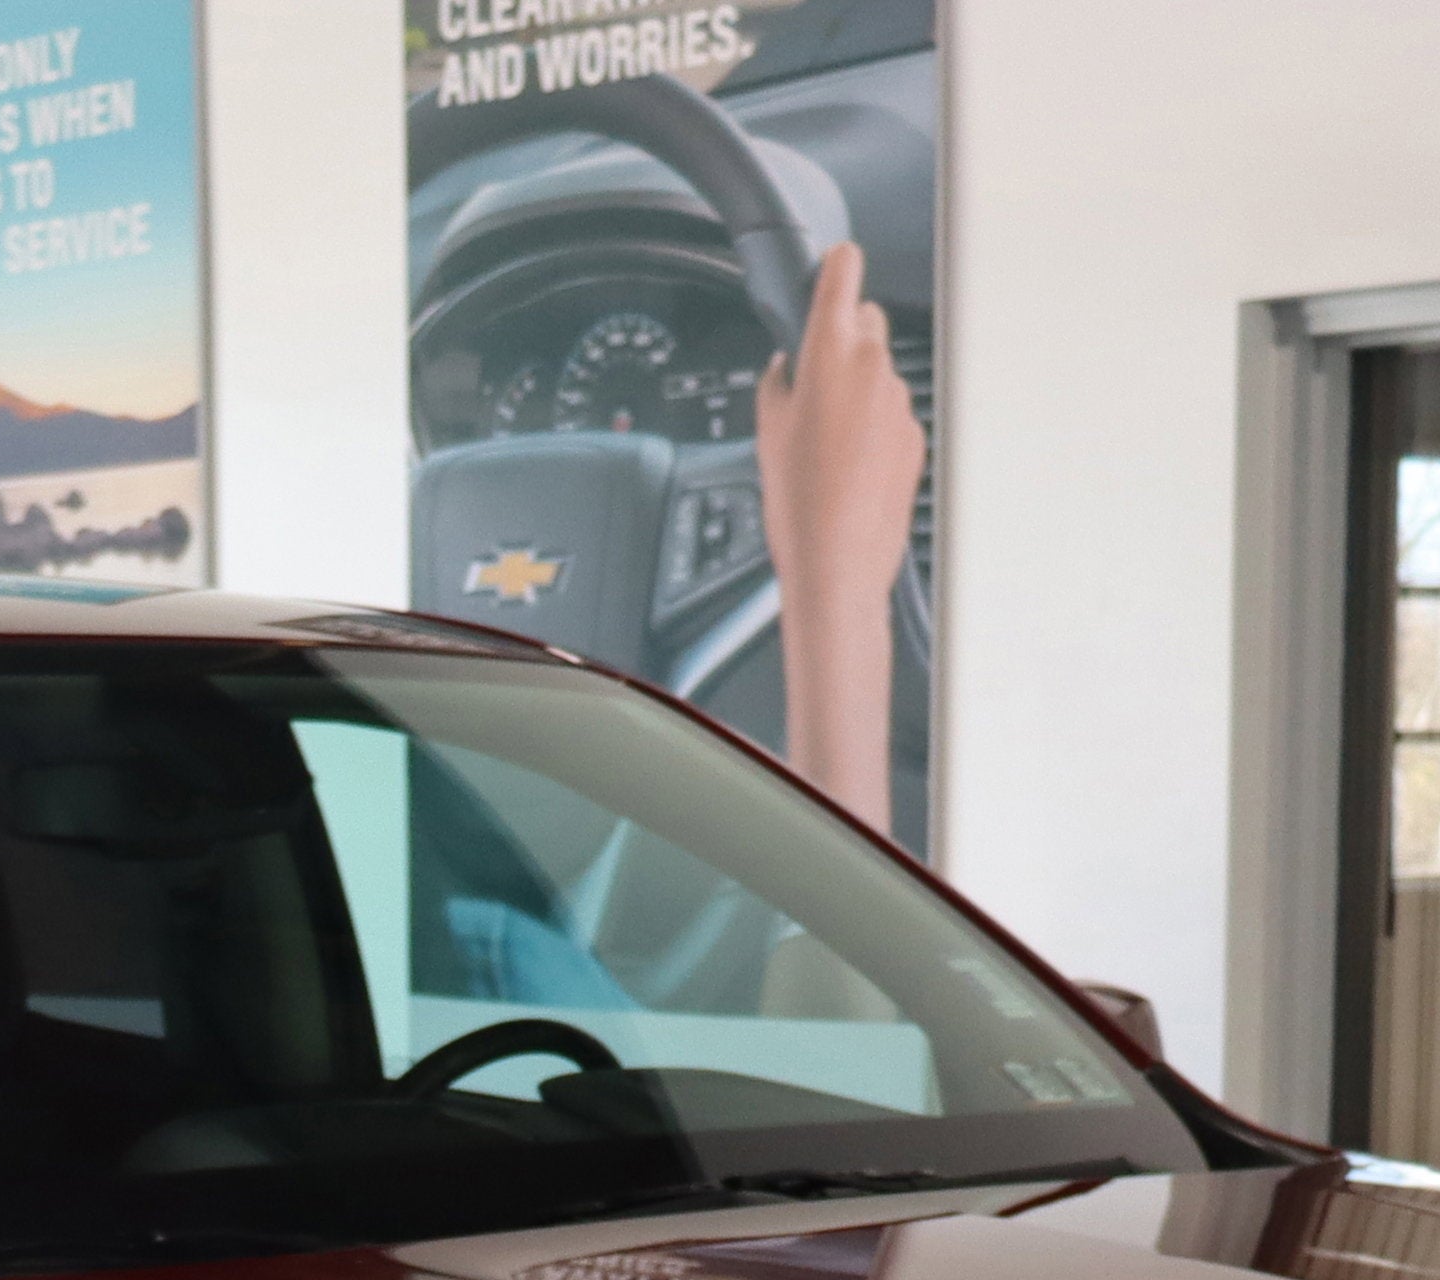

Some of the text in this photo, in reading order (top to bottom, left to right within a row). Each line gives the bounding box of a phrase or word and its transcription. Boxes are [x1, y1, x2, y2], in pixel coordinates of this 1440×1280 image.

[436, 4, 757, 109] AND WORRIES.
[26, 77, 137, 147] WHEN
[9, 157, 56, 211] TO
[2, 202, 153, 274] SERVICE
